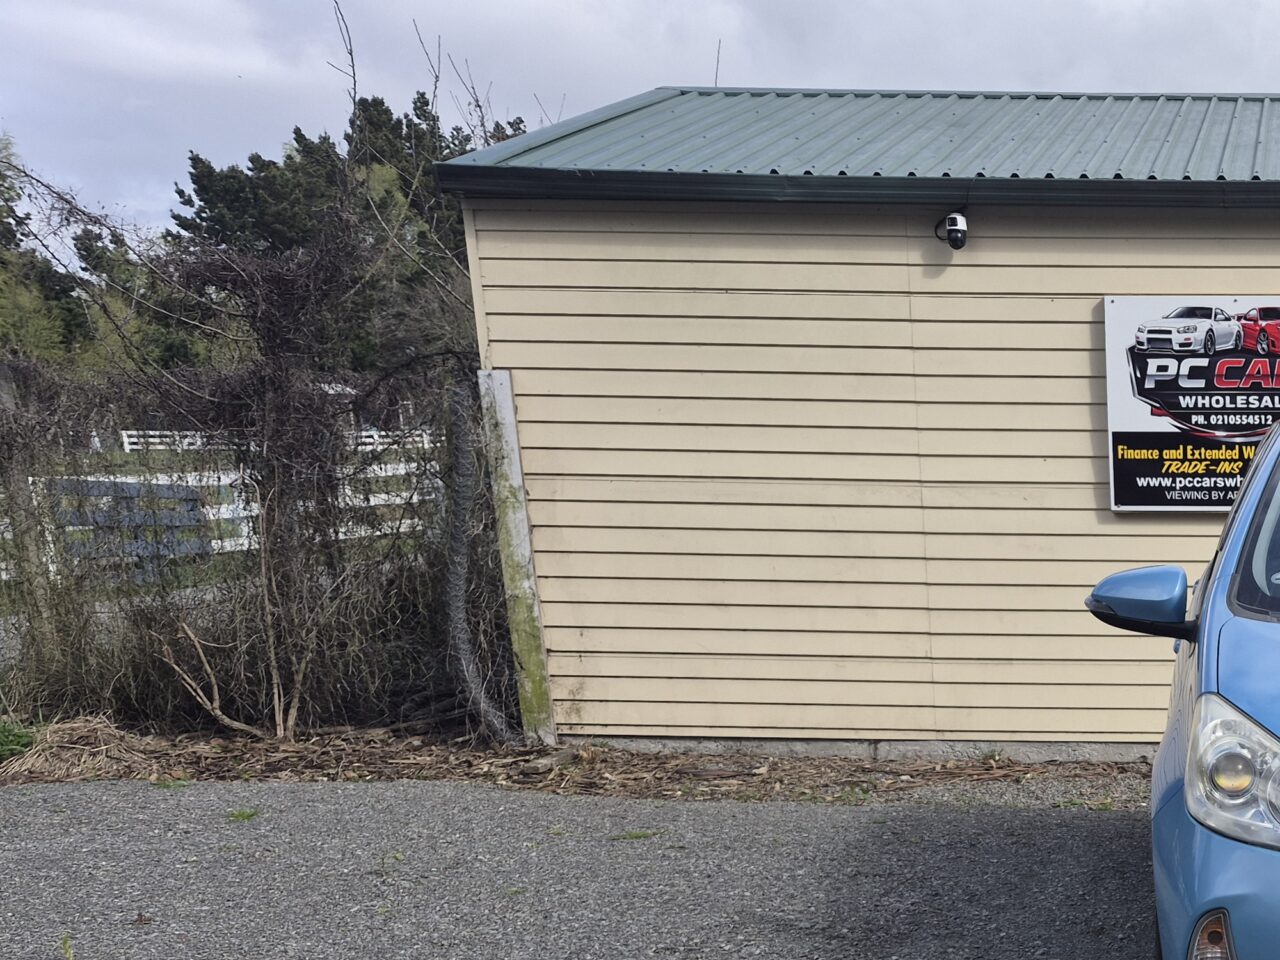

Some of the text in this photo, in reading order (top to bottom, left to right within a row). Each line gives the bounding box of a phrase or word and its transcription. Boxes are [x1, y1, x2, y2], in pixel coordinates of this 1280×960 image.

[1144, 357, 1210, 389] PC
[1191, 414, 1273, 425] PH. 0210554512
[1117, 445, 1159, 460] Finance
[1162, 445, 1183, 459] and
[1186, 445, 1239, 459] Extended
[1161, 461, 1243, 474] TRADE-INS
[1136, 475, 1245, 489] www.pccarswh
[1165, 490, 1209, 500] VIEWING
[1211, 490, 1224, 500] BY
